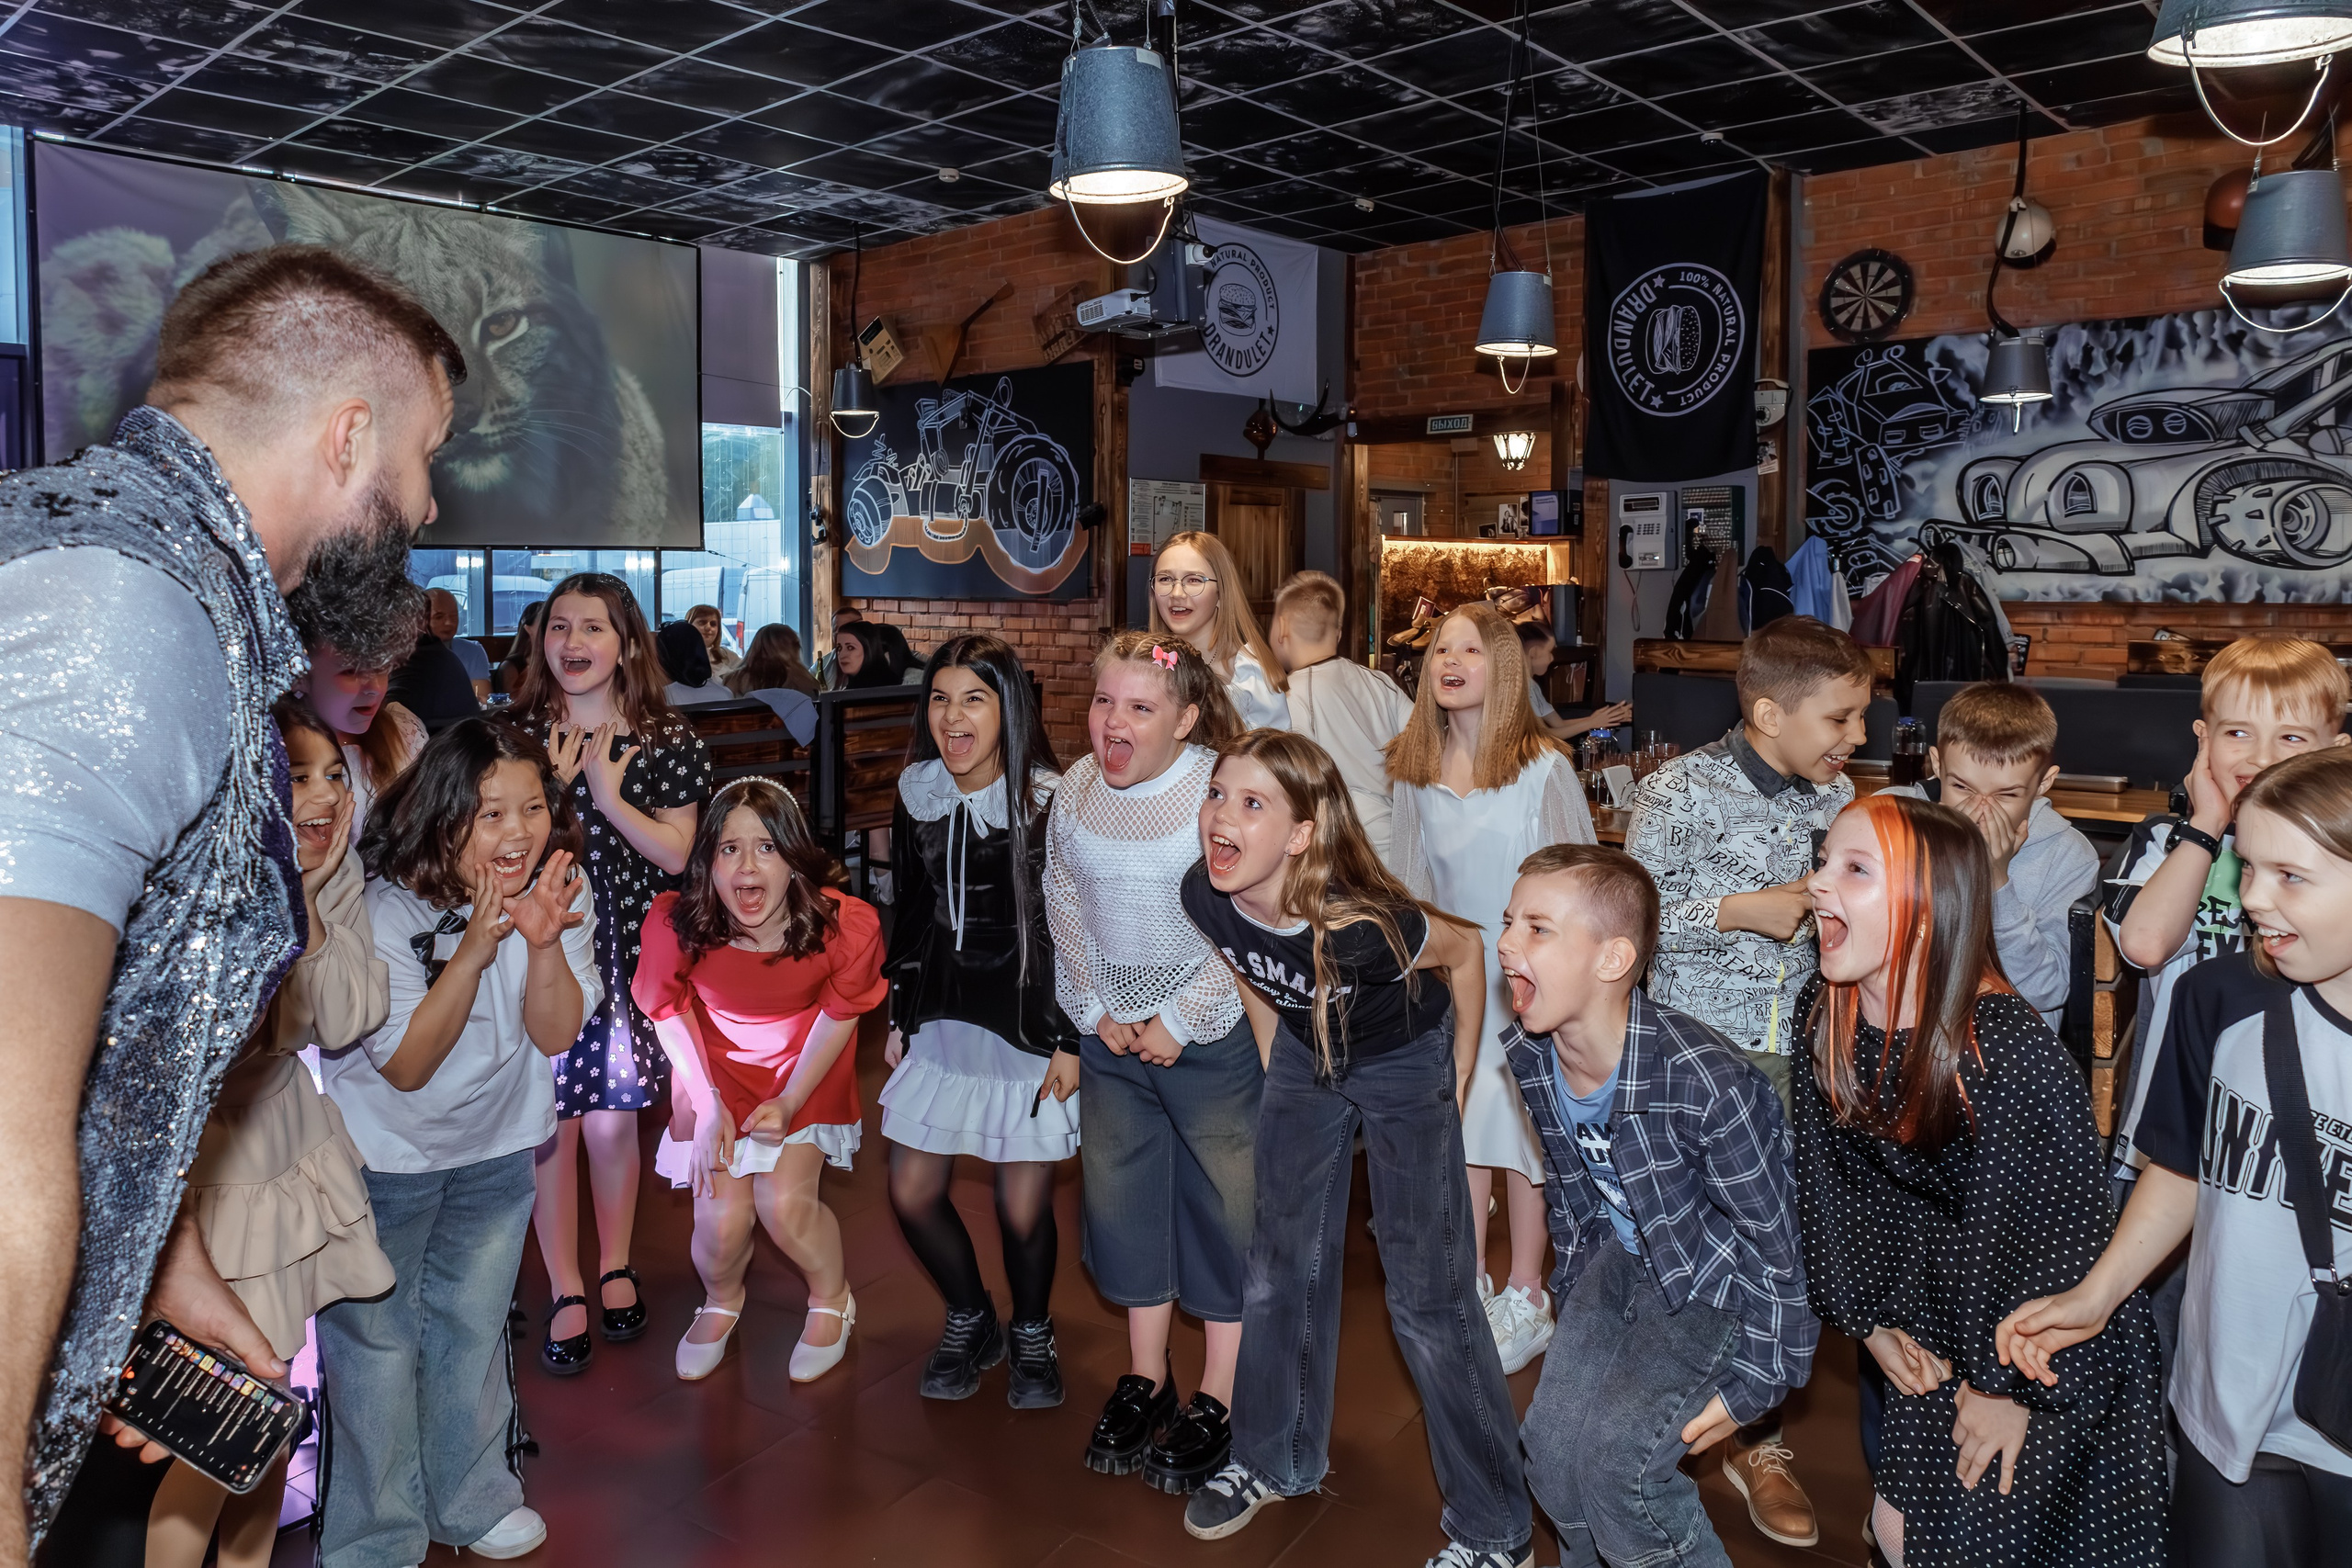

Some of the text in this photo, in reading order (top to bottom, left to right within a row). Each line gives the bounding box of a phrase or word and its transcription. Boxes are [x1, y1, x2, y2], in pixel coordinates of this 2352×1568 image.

[1211, 249, 1275, 310] NATURAL PRODUCT
[1203, 321, 1272, 369] DRANDULET
[1613, 281, 1657, 401] DRANDULET
[1679, 271, 1736, 406] 100% NATURAL PRODUCT
[1431, 418, 1468, 431] ВЫХОД
